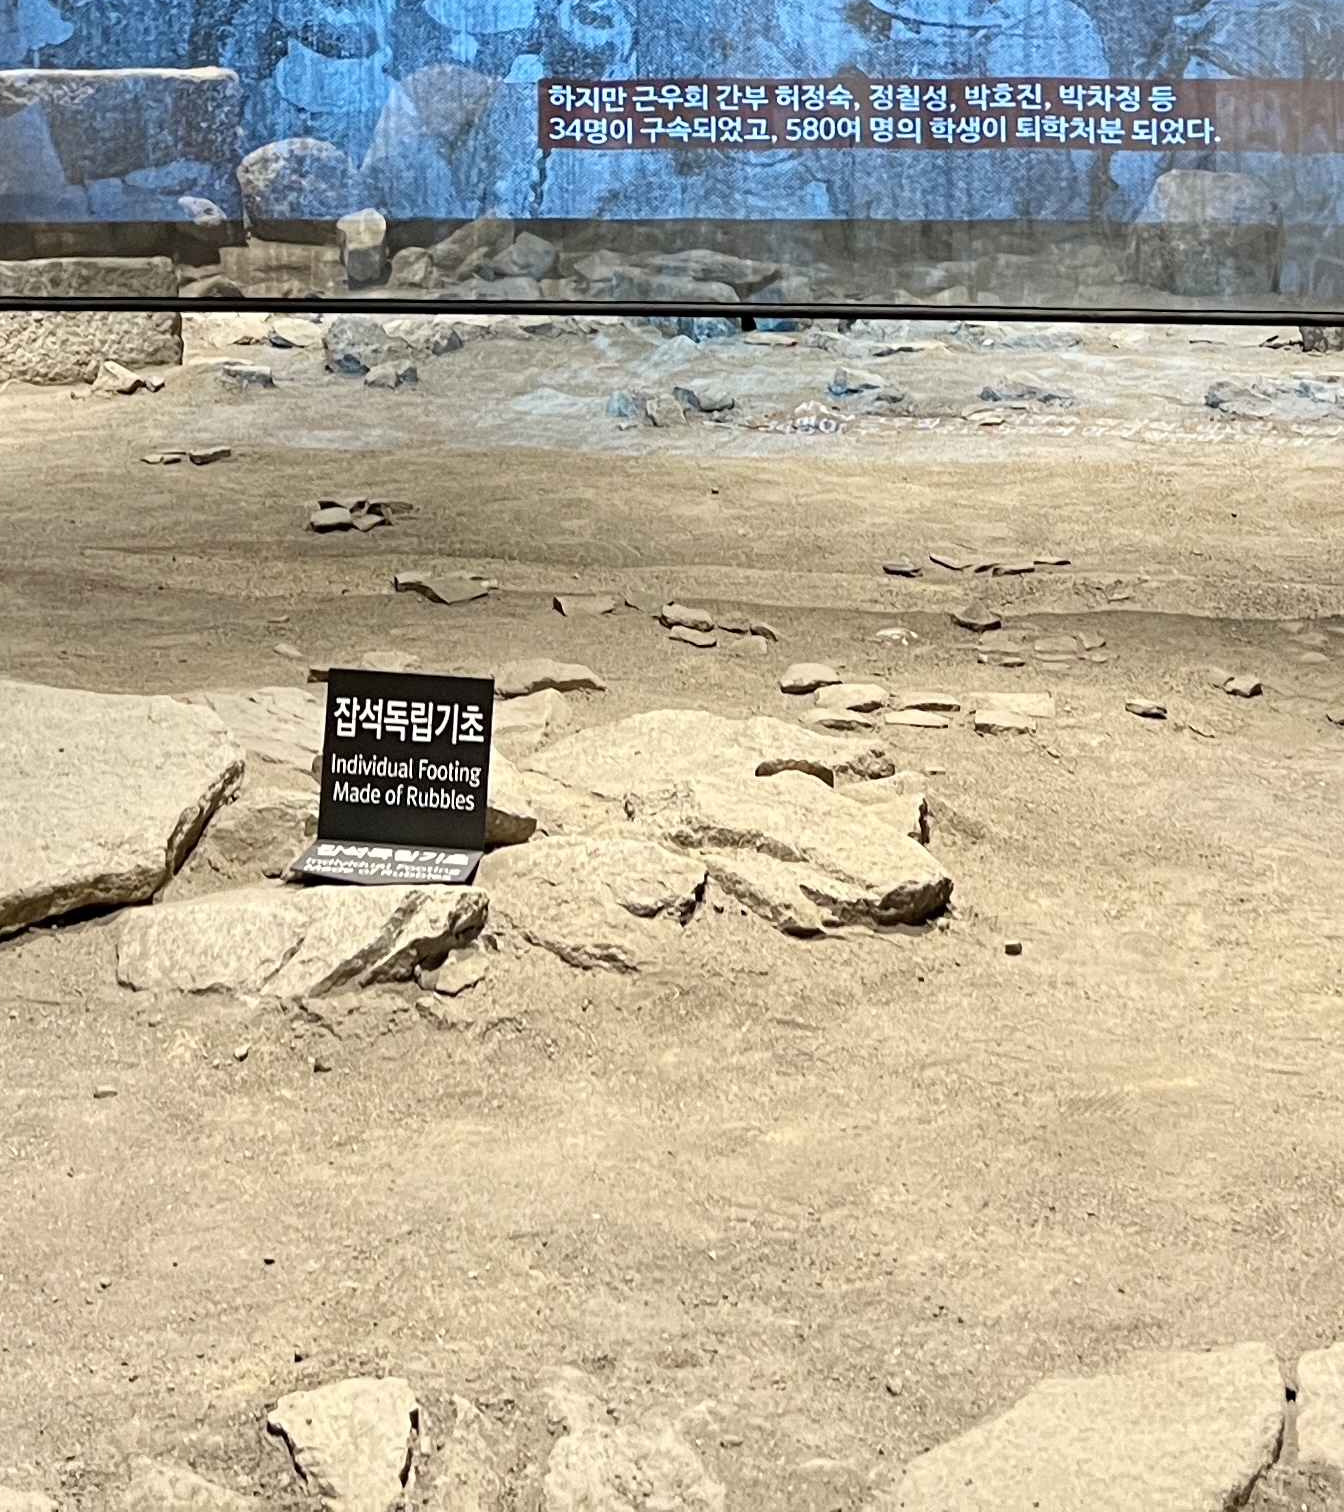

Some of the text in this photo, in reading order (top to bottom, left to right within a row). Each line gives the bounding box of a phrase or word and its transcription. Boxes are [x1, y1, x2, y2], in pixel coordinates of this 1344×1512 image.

[548, 82, 1176, 113] 하지만 근우회 간부 허정숙, 정칠성, 박호진, 박차정 등
[549, 115, 1221, 145] 34명이 구속되었고, 580여 명의 학생이 퇴학처분 되었다.
[333, 696, 485, 745] 잡석독립기초
[331, 752, 482, 788] Individual Footing
[332, 781, 475, 812] Made of Rubbles
